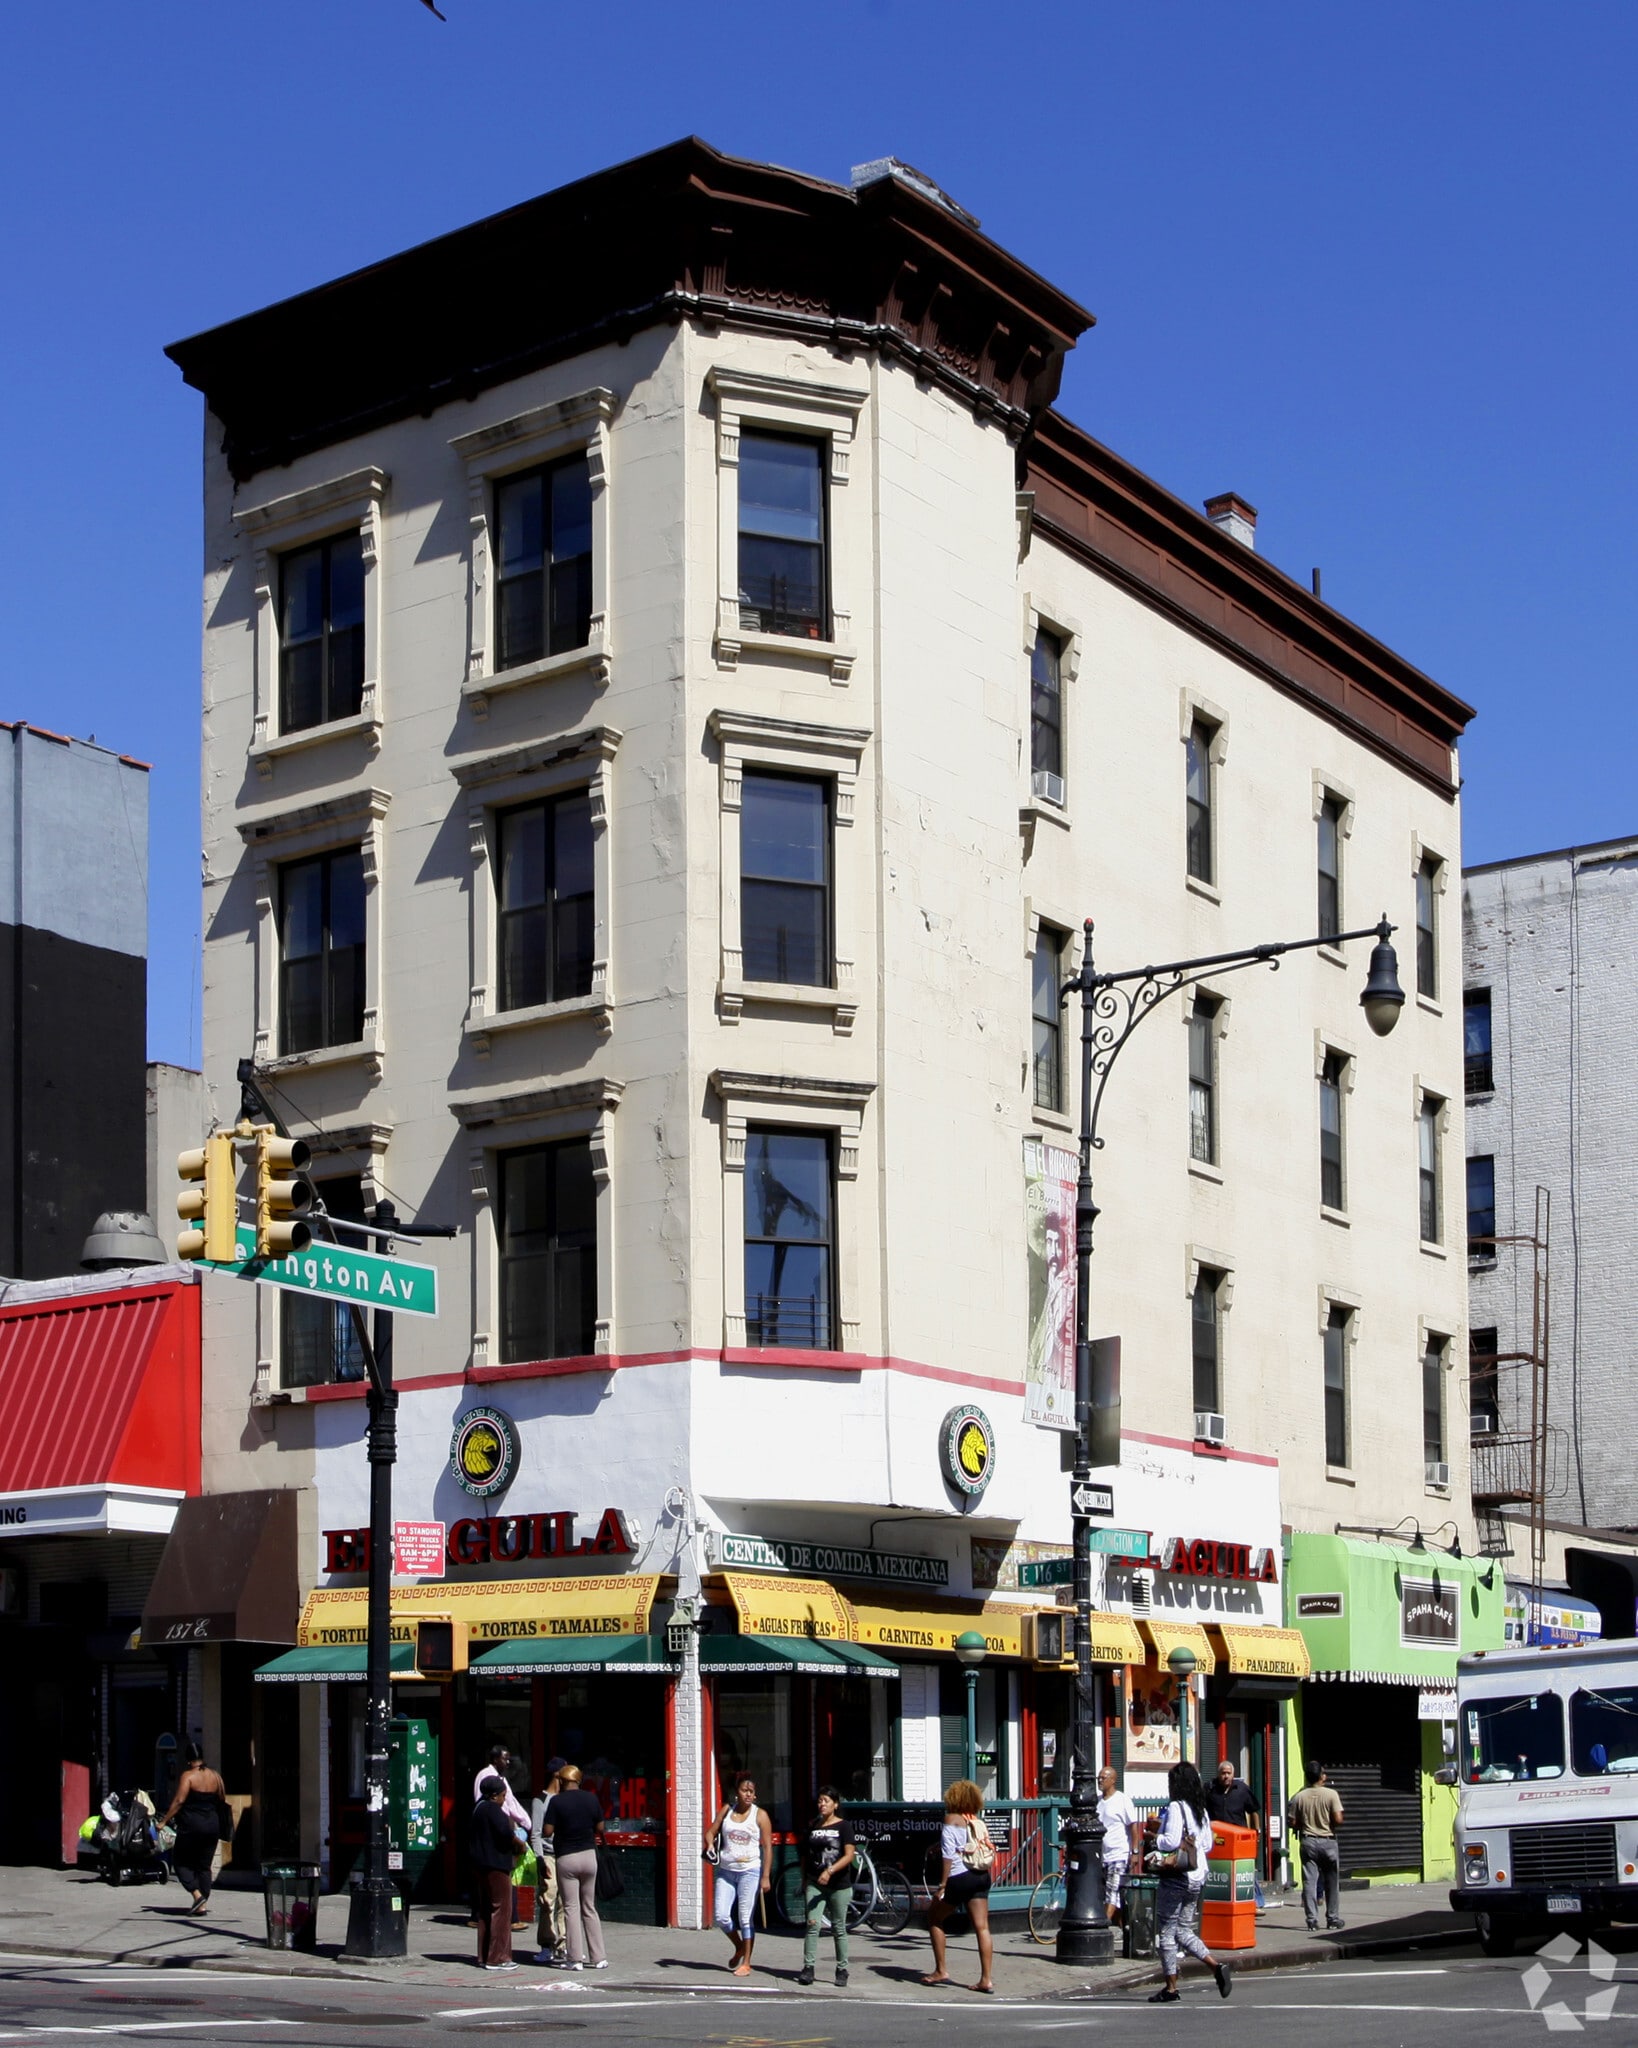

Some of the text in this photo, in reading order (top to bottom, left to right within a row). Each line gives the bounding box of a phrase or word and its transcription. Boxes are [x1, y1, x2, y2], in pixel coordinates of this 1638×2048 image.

[378, 1270, 414, 1300] Av
[1031, 1409, 1070, 1426] EL AGUILA
[1077, 1491, 1109, 1506] ONE WAY
[397, 1526, 441, 1536] NO STANDING
[399, 1535, 418, 1543] EXCEPT
[446, 1508, 638, 1566] GUILA
[723, 1537, 948, 1582] CENTRO DE COMIDA MEXICANA
[1168, 1537, 1278, 1584] AGUILA
[1022, 1561, 1068, 1586] E 116 ST
[1406, 1603, 1454, 1626] SPAHA CAFÉ
[165, 1622, 194, 1640] 137
[480, 1620, 537, 1638] TORTAS
[549, 1616, 621, 1635] TAMALES
[758, 1616, 831, 1637] AGUAS FRESCAS
[879, 1627, 934, 1647] CARNITAS
[1245, 1659, 1296, 1675] PANADERIA
[1522, 1791, 1557, 1800] Little
[867, 1817, 901, 1832] Street
[902, 1818, 943, 1832] Station
